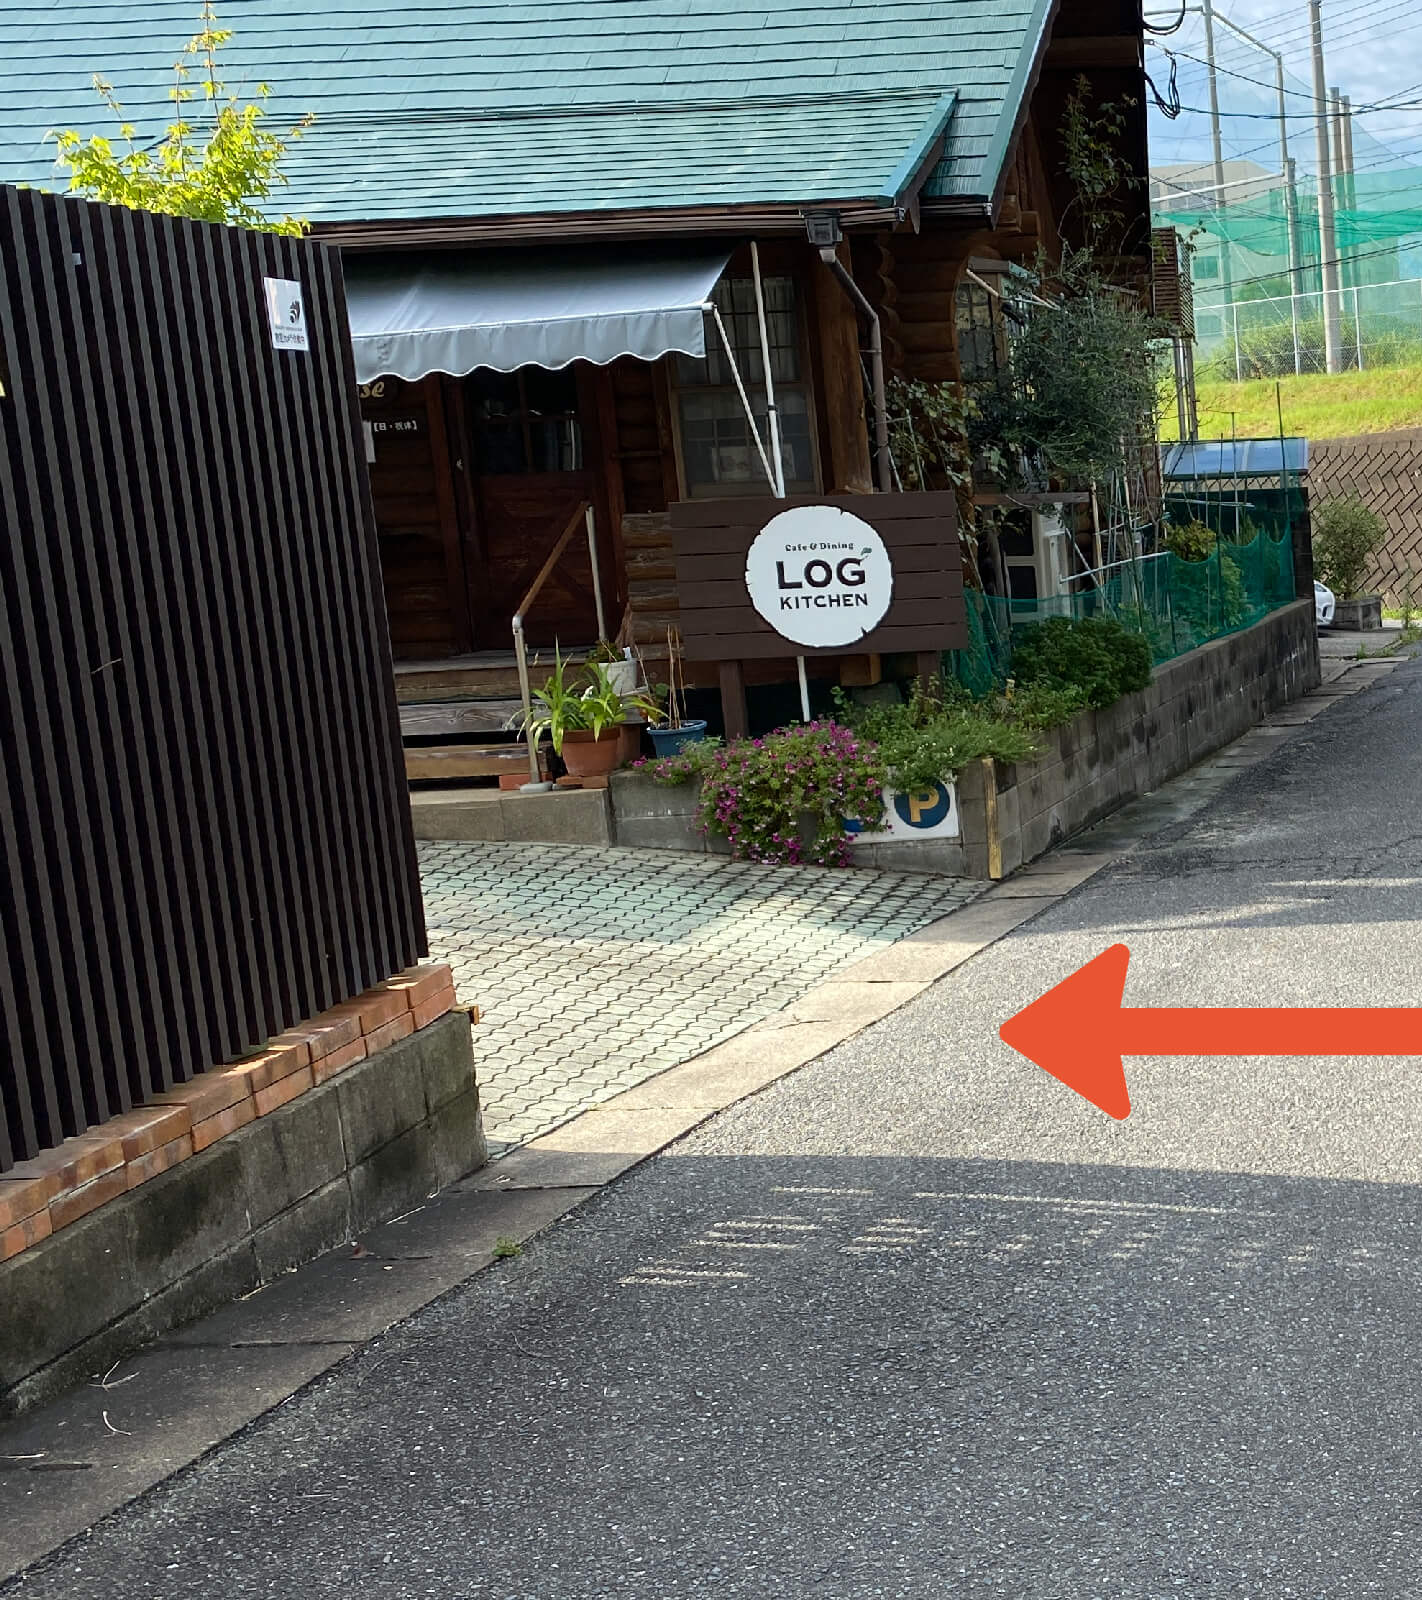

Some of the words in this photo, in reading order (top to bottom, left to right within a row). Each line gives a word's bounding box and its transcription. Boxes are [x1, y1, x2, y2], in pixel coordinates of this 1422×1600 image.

[809, 542, 818, 551] &
[819, 541, 854, 550] Dining
[776, 558, 866, 589] LOG
[780, 593, 868, 610] KITCHEN
[909, 785, 939, 822] P
